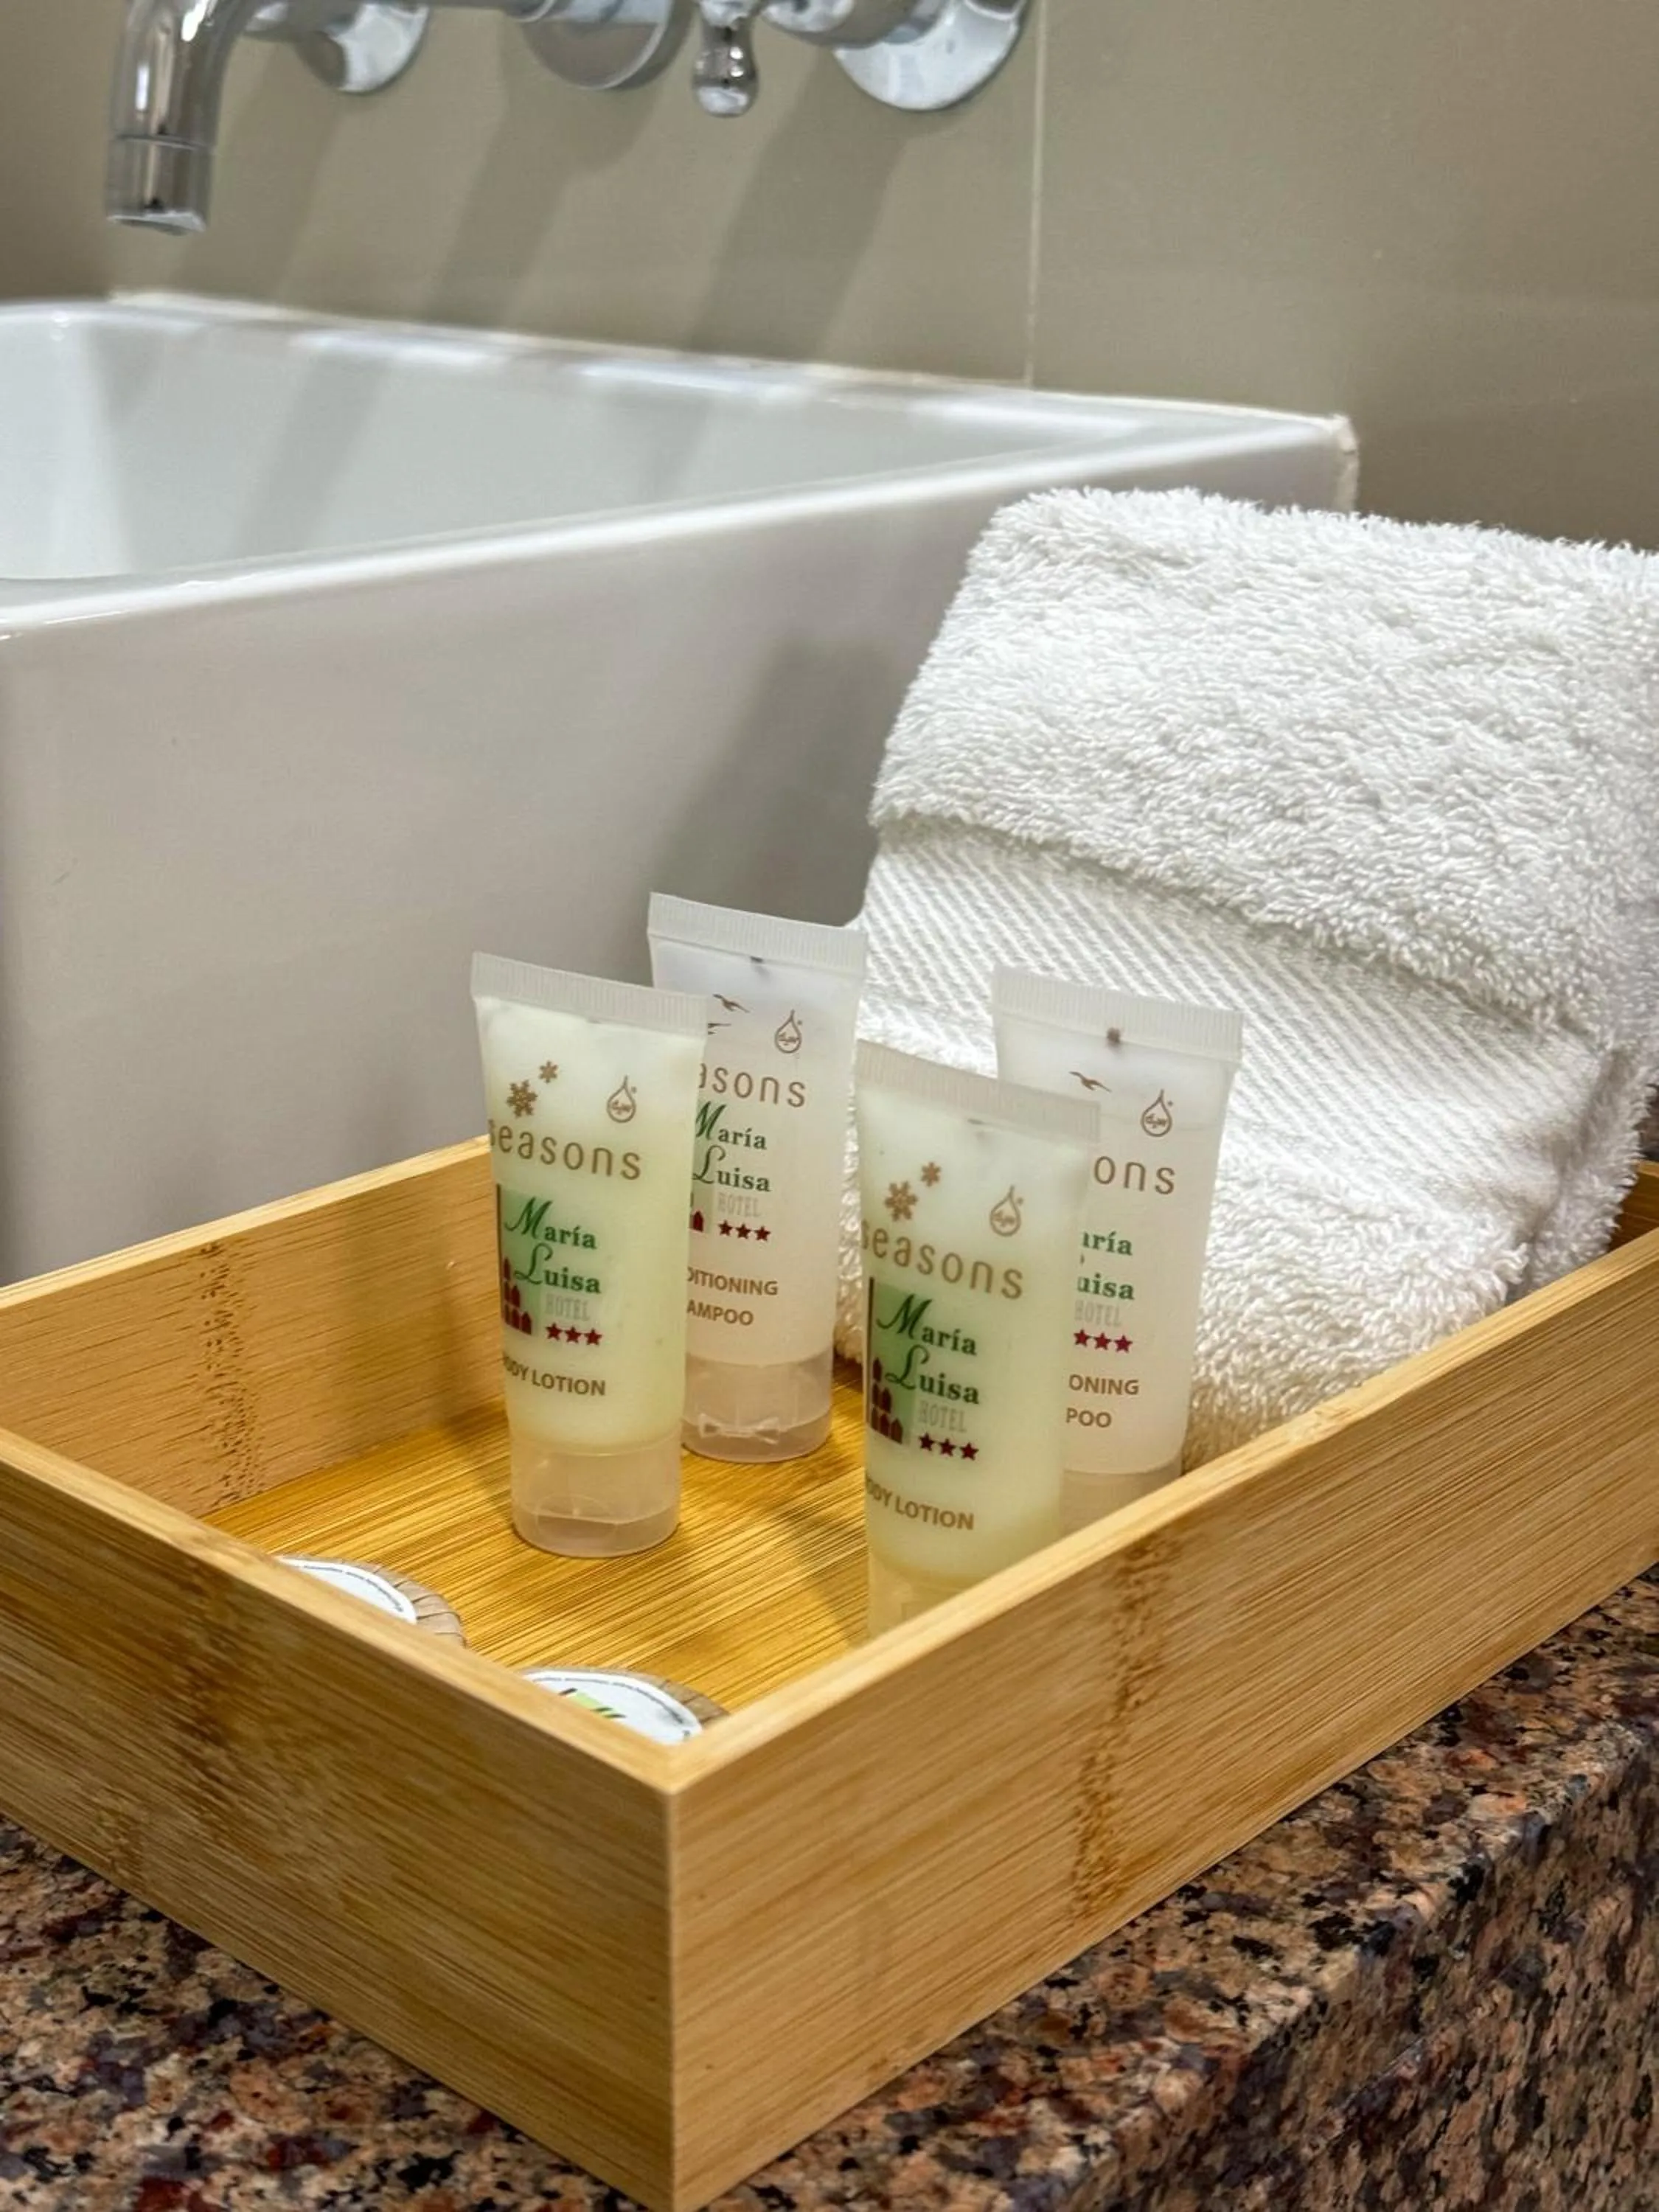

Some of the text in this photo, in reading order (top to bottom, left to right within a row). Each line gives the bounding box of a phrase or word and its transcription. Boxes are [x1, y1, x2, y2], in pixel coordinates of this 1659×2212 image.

[695, 1100, 768, 1150] María
[692, 1145, 771, 1192] Luisa
[1093, 1155, 1176, 1195] ons
[504, 1197, 598, 1249] María
[513, 1242, 602, 1294] Luisa
[1077, 1271, 1135, 1301] uisa
[546, 1293, 590, 1321] HOTEL
[686, 1298, 754, 1326] AMPOO
[876, 1293, 977, 1356] María
[532, 1368, 605, 1397] LOTION
[885, 1344, 980, 1405] Luisa
[1068, 1374, 1140, 1396] ONING
[918, 1402, 967, 1433] HOTEL
[1065, 1407, 1112, 1428] POO
[895, 1495, 975, 1531] LOTION
